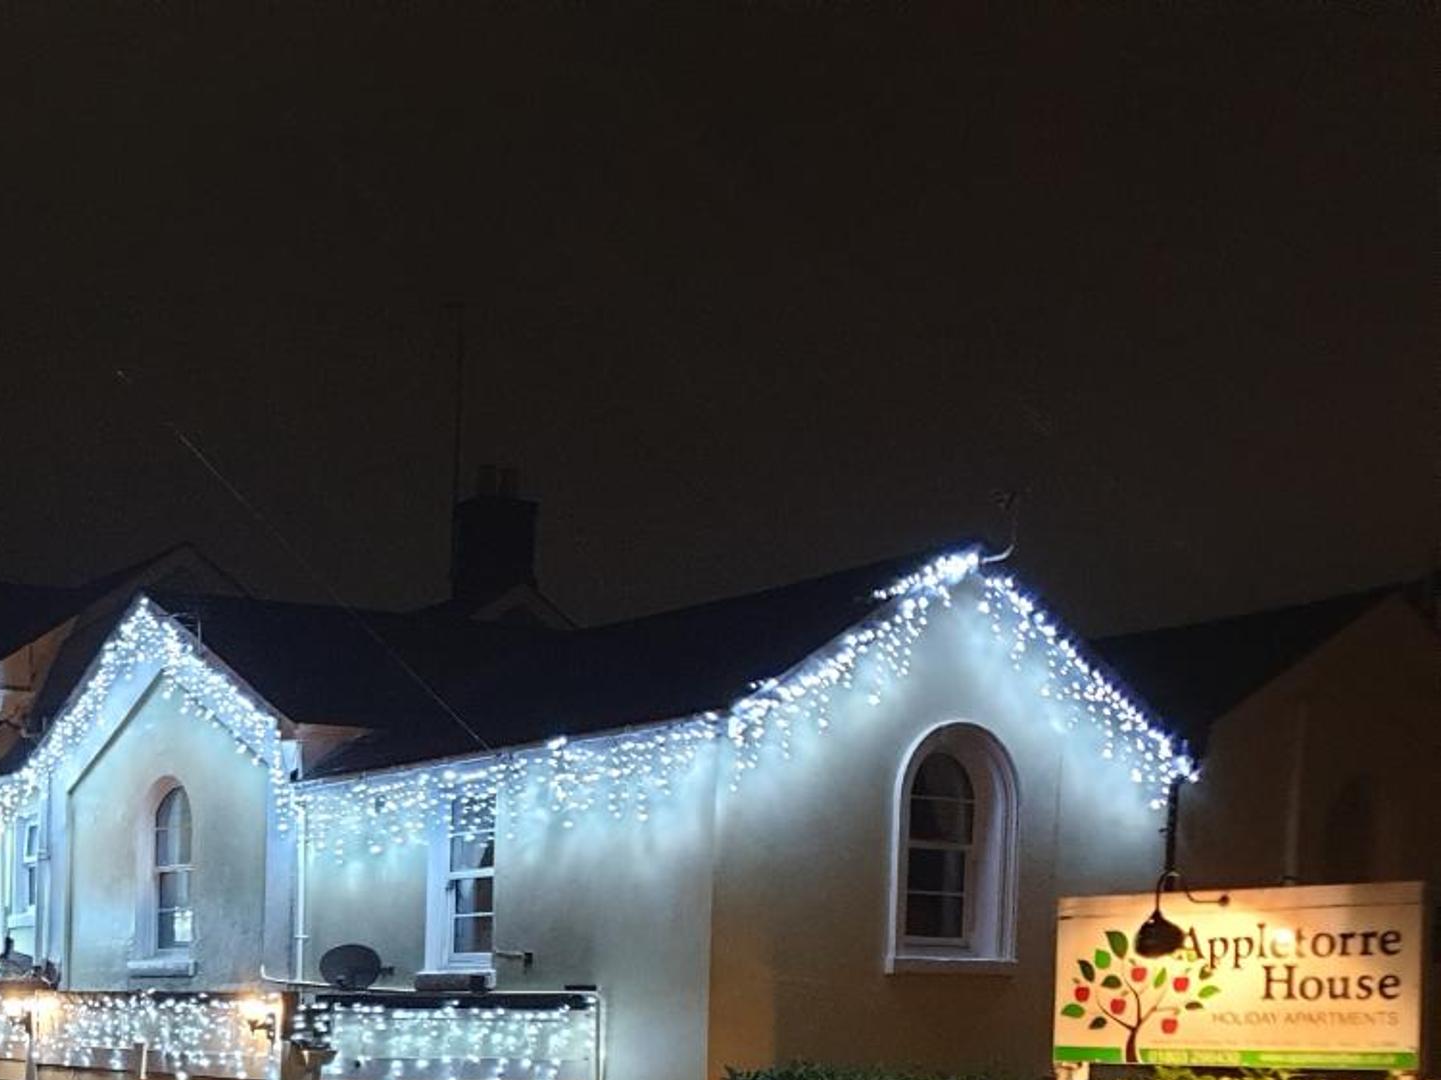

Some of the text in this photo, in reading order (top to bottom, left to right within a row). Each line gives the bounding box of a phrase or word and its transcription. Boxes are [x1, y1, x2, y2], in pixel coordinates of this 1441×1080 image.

[1262, 964, 1401, 1001] House
[1212, 1010, 1399, 1027] HOLIDAY APARTMENTS
